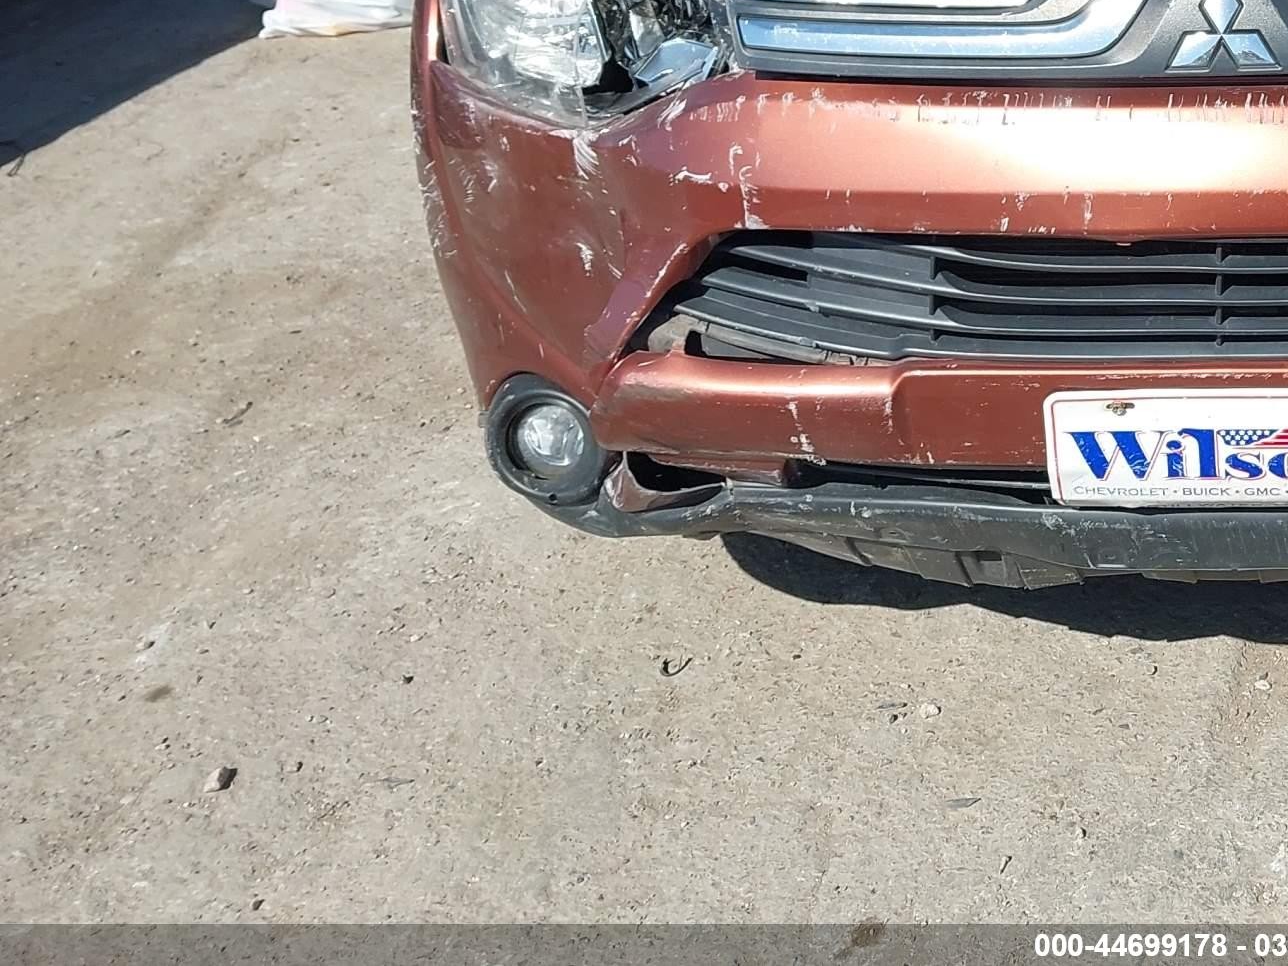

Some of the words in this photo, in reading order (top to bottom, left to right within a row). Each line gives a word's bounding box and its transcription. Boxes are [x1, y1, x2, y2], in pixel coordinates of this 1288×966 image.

[1073, 485, 1168, 497] CHEVROLET
[1182, 486, 1230, 497] BUICK
[1244, 487, 1281, 497] GMC
